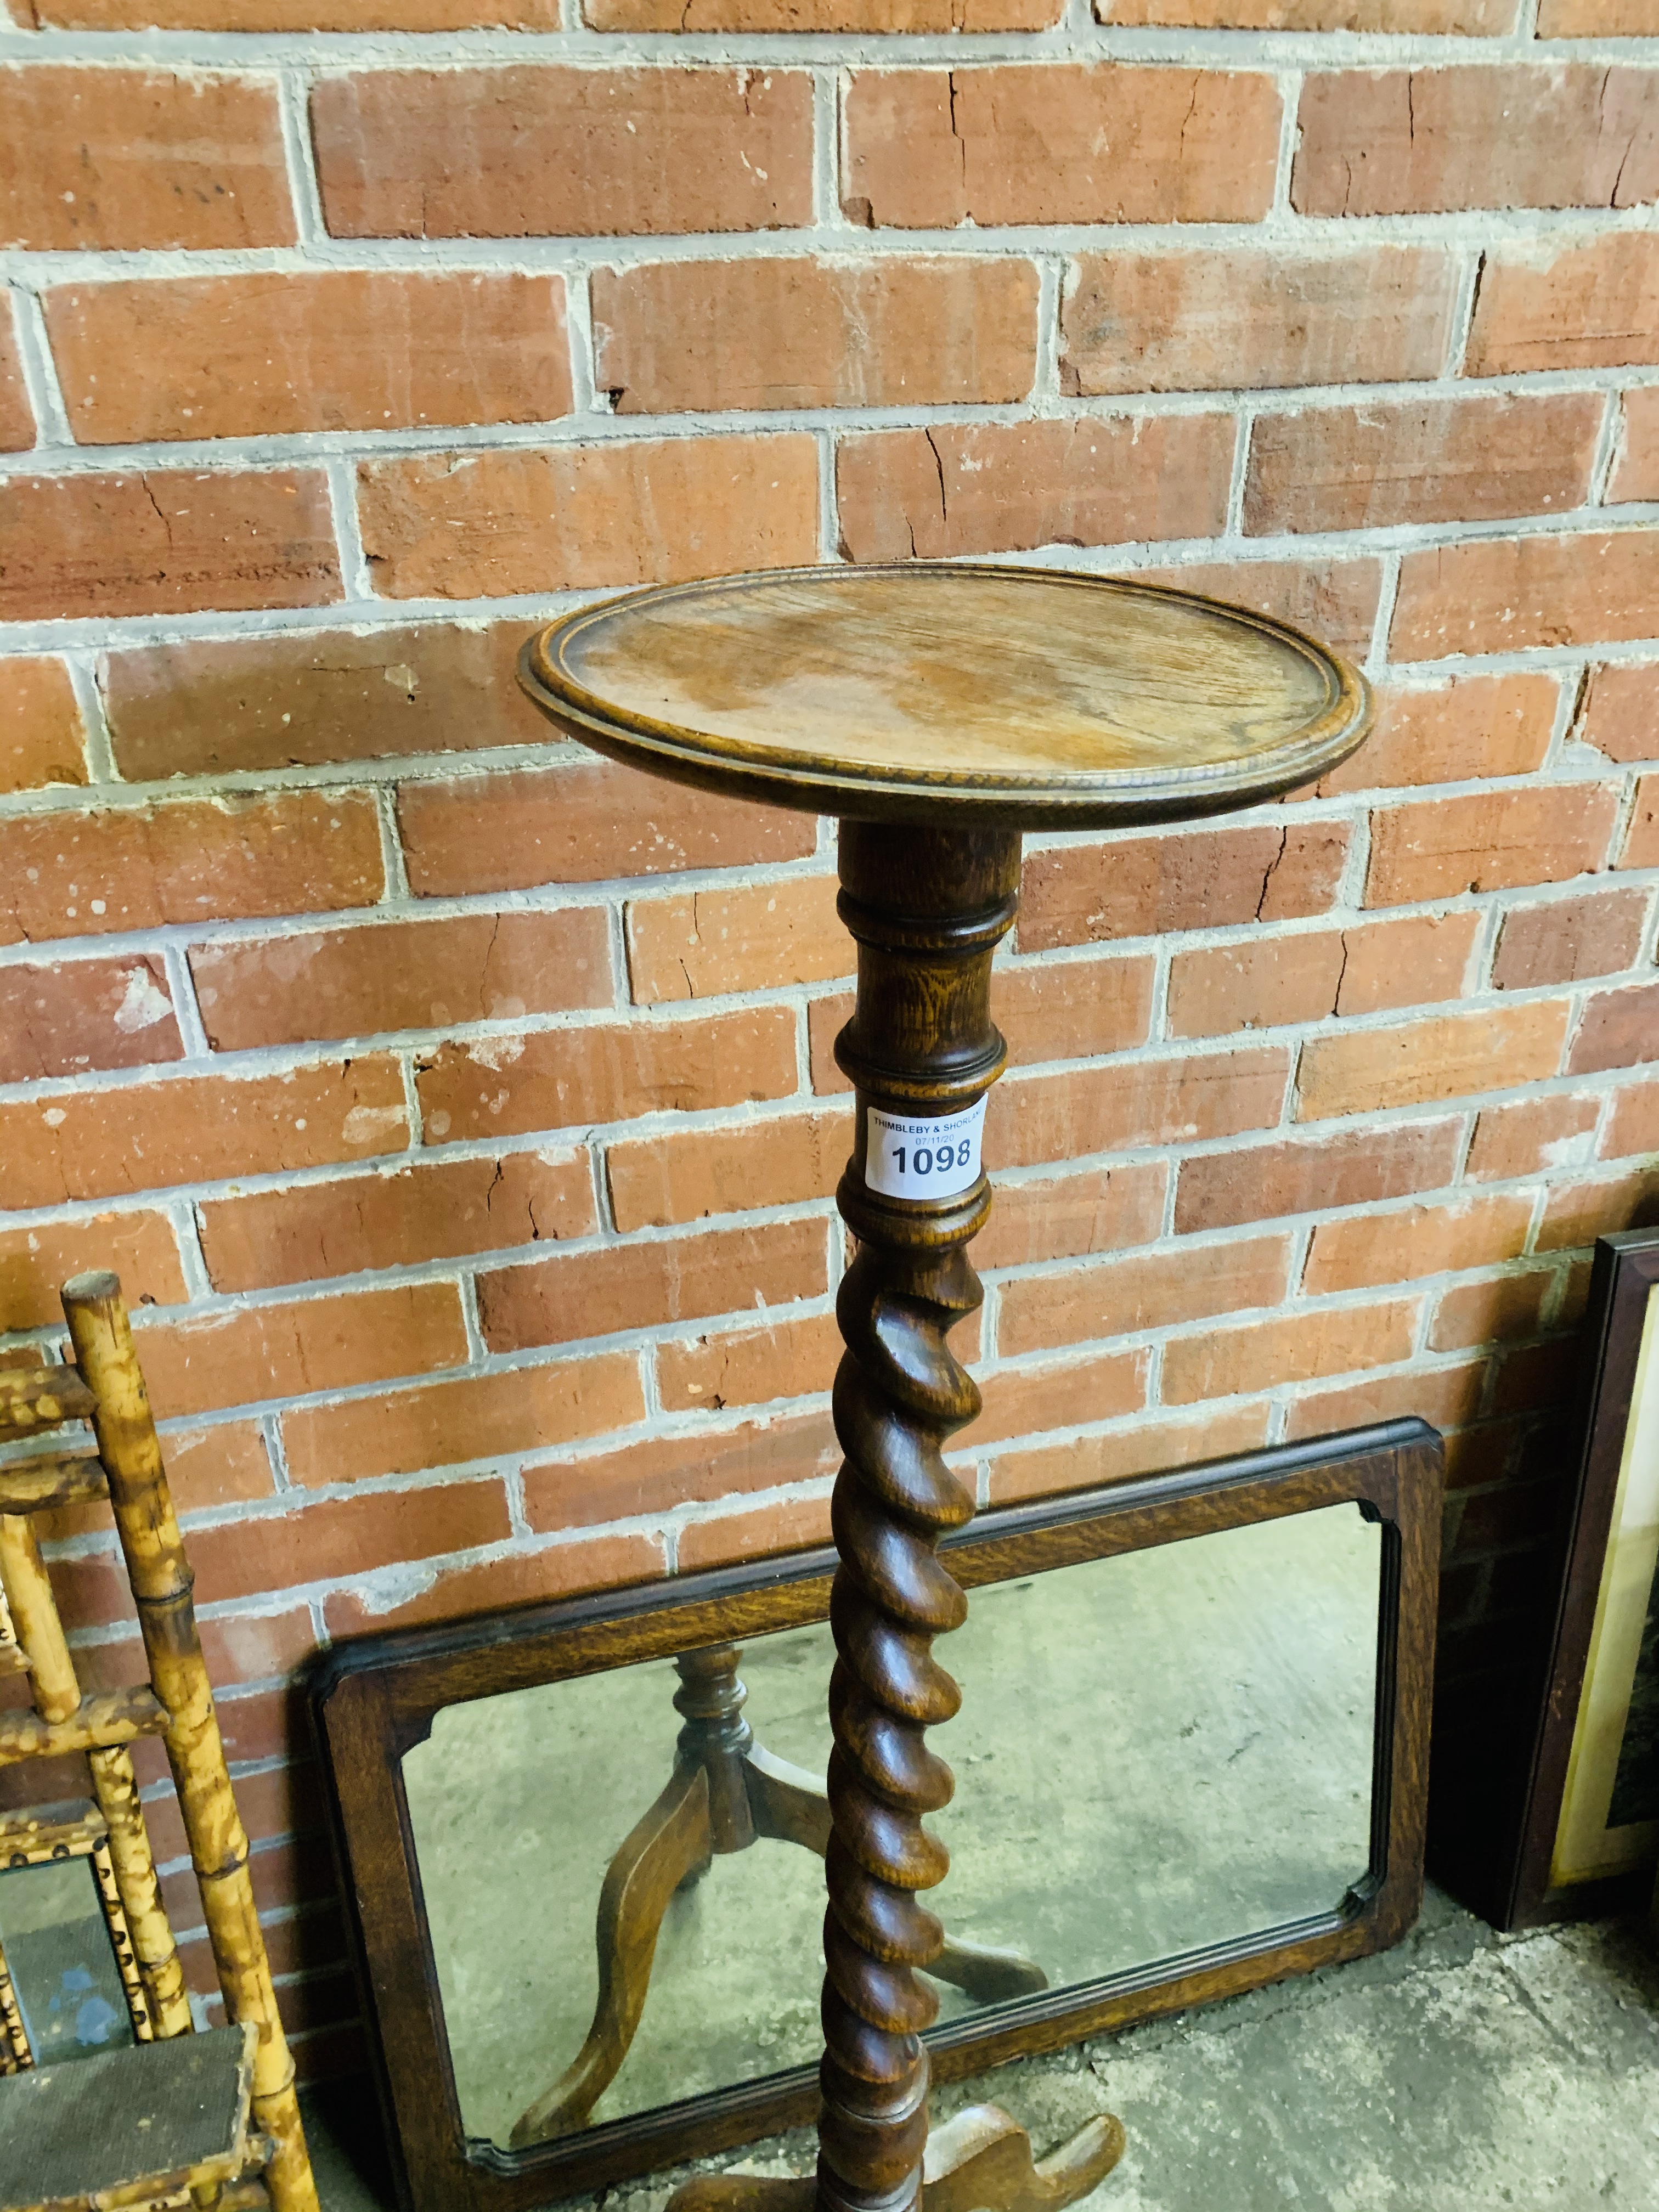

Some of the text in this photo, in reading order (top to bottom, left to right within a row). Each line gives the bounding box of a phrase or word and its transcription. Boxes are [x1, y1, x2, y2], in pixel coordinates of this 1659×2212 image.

[873, 1116, 930, 1133] THIMBLEBY
[916, 1134, 955, 1145] 07/11/20
[892, 1138, 970, 1175] 1098
